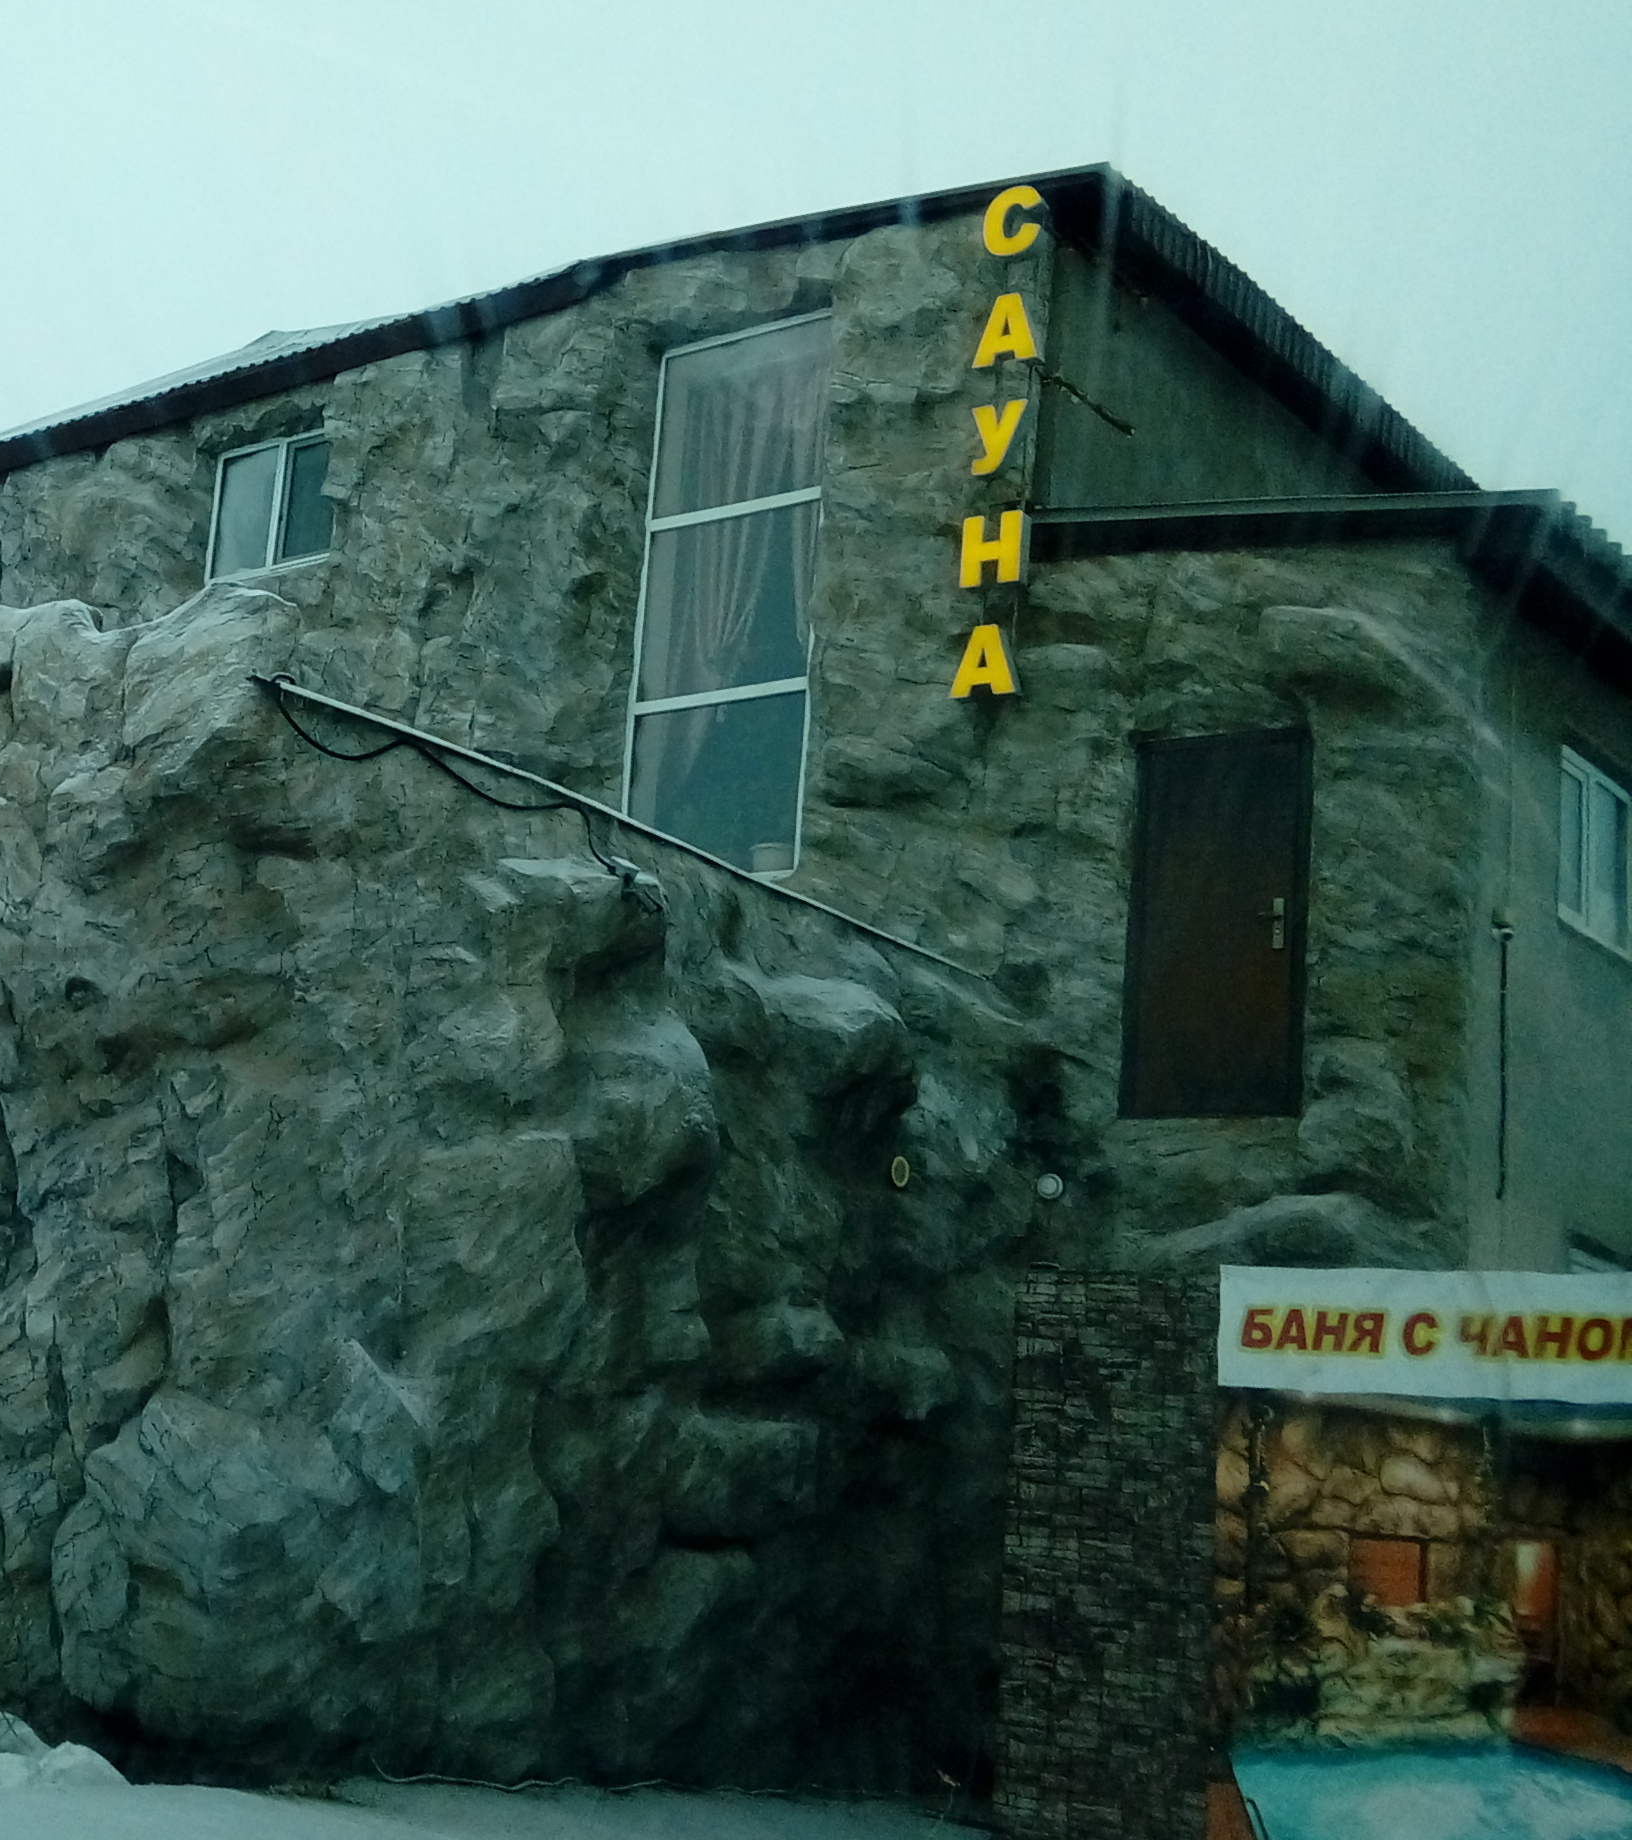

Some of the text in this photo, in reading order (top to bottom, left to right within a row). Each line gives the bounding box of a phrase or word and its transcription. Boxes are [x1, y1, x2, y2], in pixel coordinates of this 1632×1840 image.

[948, 185, 1045, 699] САУНА
[1240, 1307, 1386, 1354] БАНЯ
[1402, 1312, 1439, 1357] С
